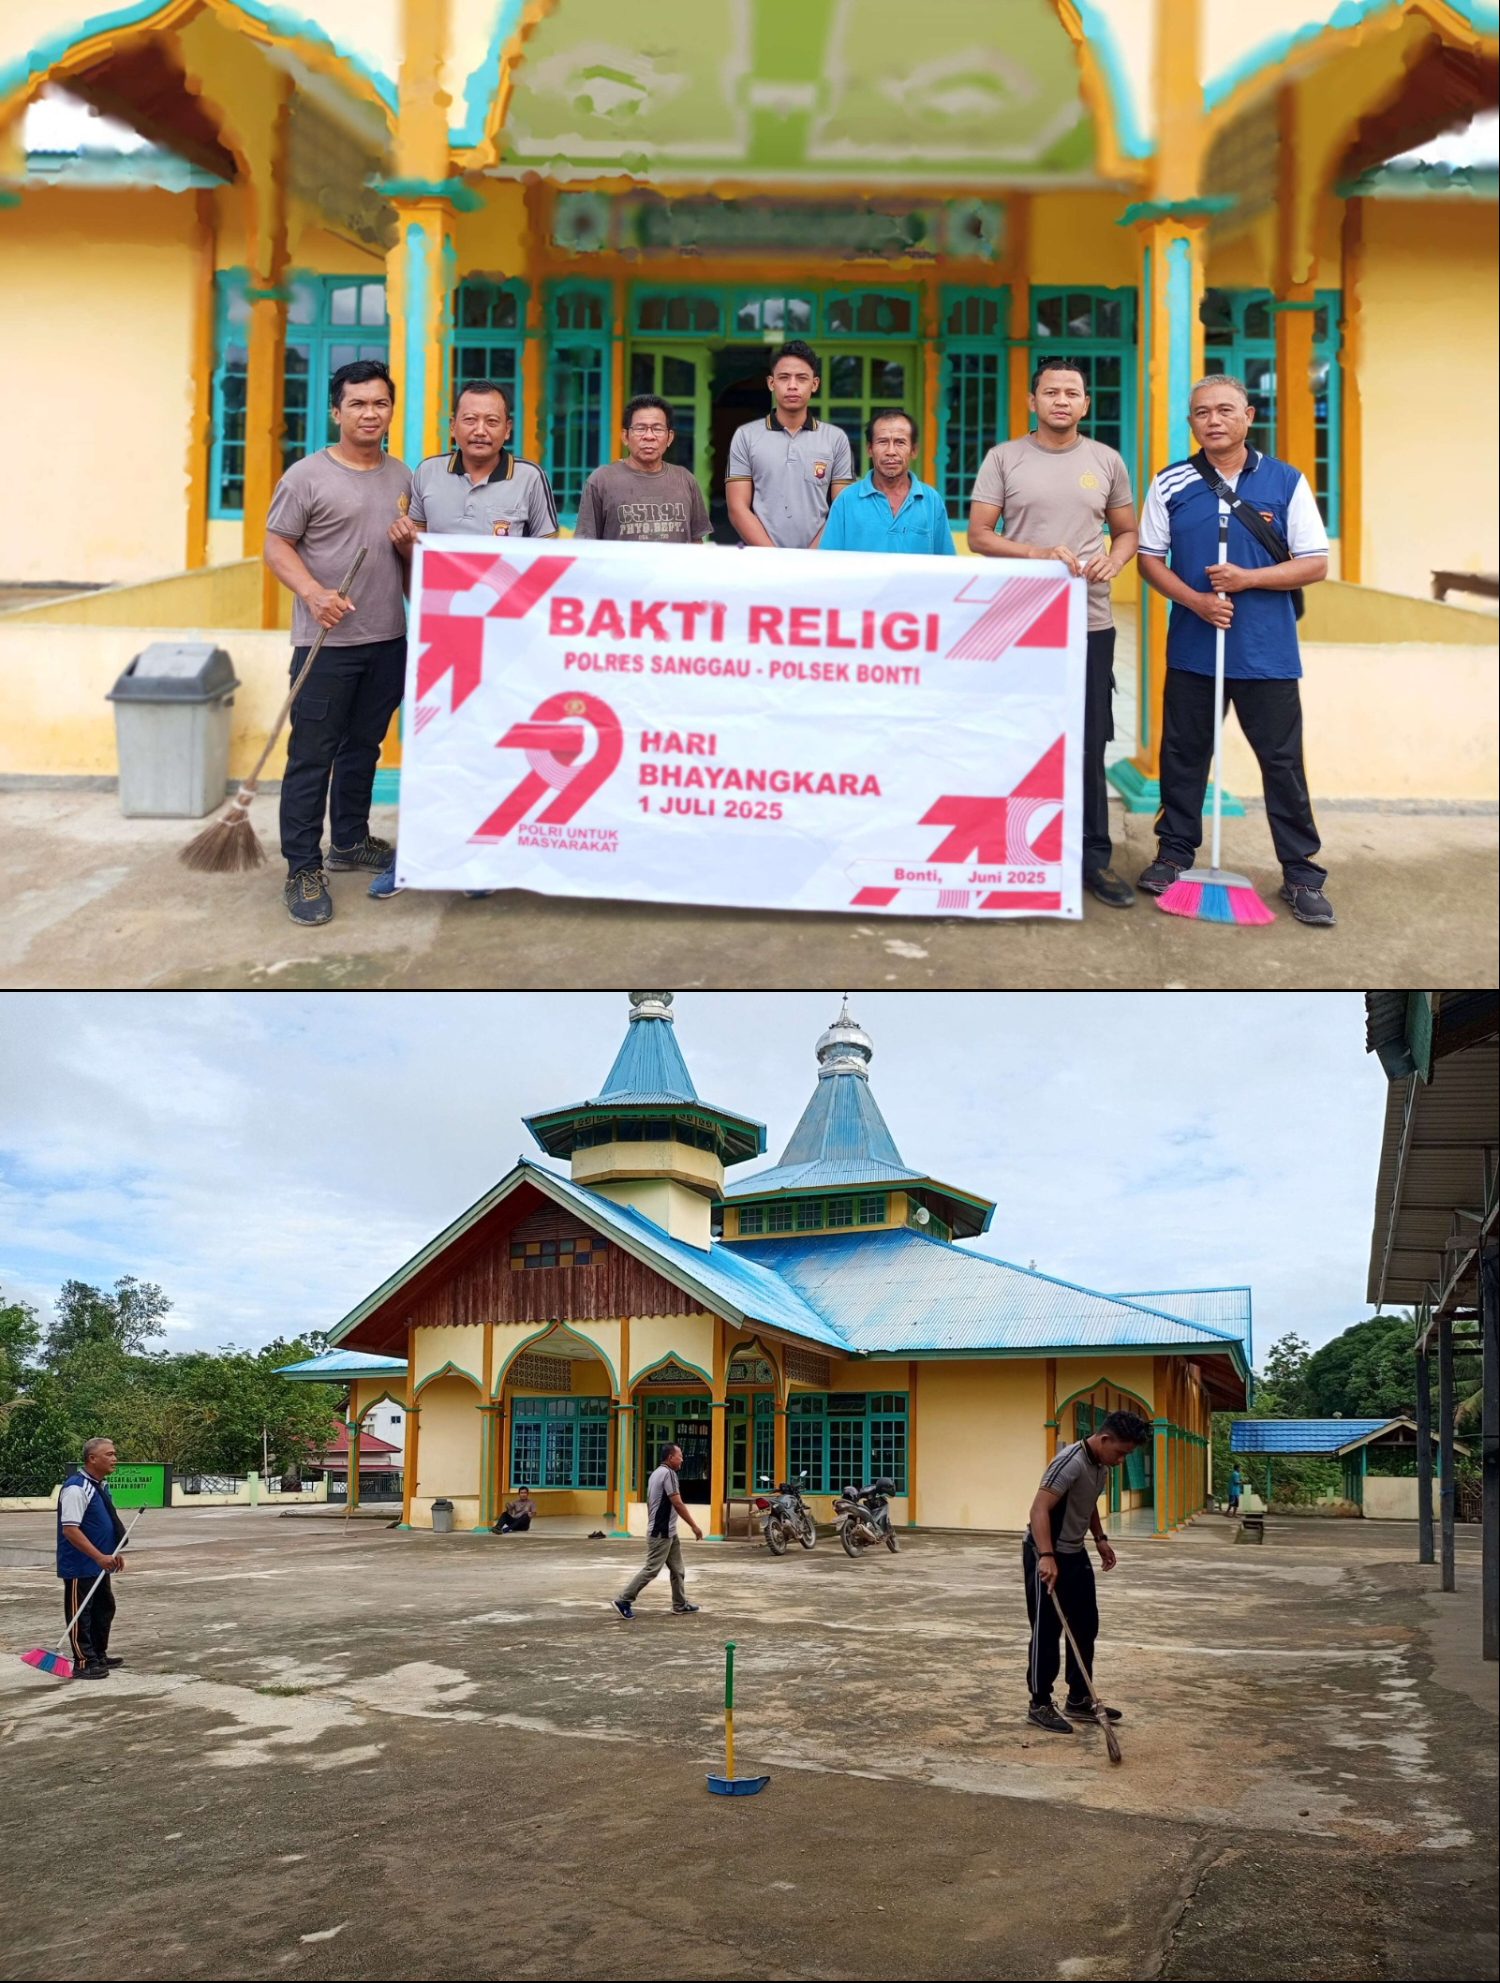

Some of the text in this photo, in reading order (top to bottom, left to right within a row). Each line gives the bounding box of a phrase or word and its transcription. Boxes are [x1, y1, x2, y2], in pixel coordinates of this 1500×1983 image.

[548, 596, 940, 652] BAKTI RELIGI
[564, 651, 645, 673] POLRES
[650, 654, 751, 678] SANGGAU
[769, 659, 850, 682] POLSEK
[857, 664, 921, 685] BONTI
[639, 730, 717, 757] HARI
[638, 763, 882, 797] BHAYANGKARA
[638, 795, 783, 820] 1 JULI 2025
[517, 836, 619, 853] MASYARAKAT
[518, 824, 618, 841] POLRI UNTUK
[894, 867, 1046, 884] Bonti, Juni 2025
